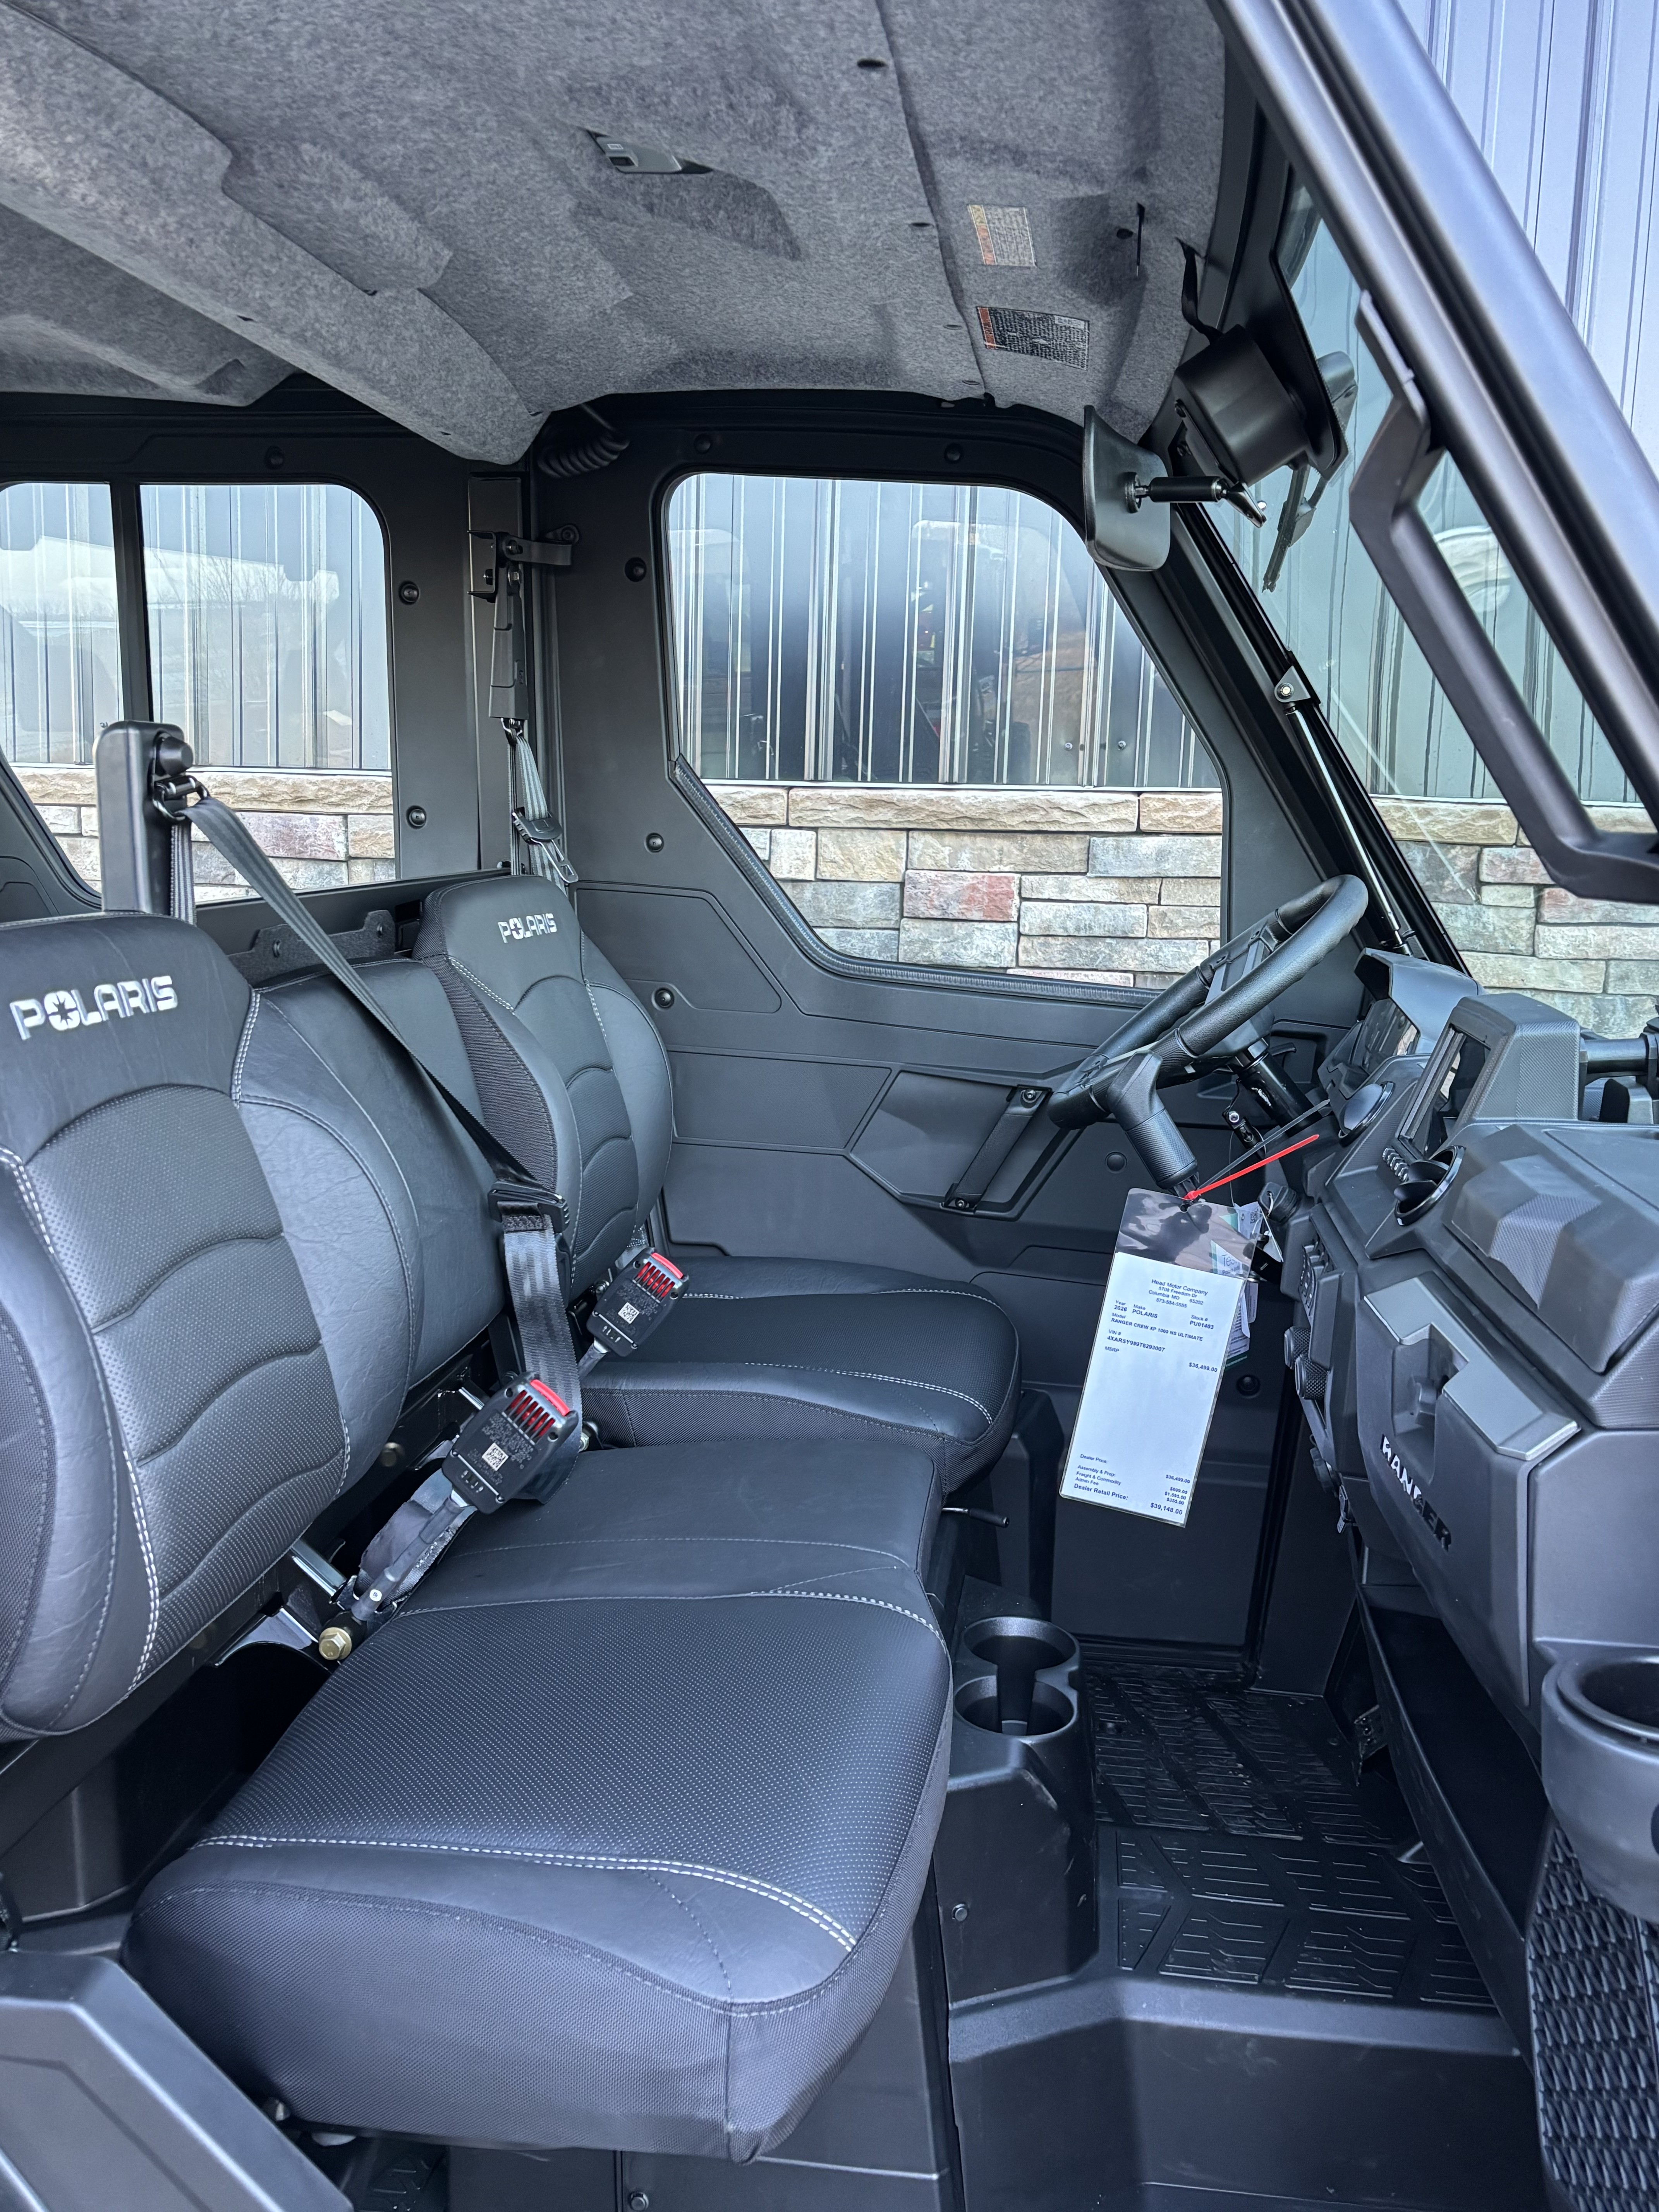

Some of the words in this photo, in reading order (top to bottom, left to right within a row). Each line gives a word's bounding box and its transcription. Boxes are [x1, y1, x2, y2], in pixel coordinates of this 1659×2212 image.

[498, 913, 557, 943] POLARIS
[9, 975, 178, 1041] POLARIS
[1183, 1286, 1208, 1296] Company
[1132, 1309, 1158, 1318] POLARIS
[1111, 1318, 1132, 1326] RANGER
[1178, 1333, 1203, 1341] ULTIMATE
[1190, 1321, 1214, 1329] PU01403
[1188, 1362, 1218, 1372] $36,499.00
[1077, 1465, 1099, 1474] Assembly
[1076, 1471, 1092, 1479] Freight
[1097, 1476, 1121, 1486] Commodity
[1074, 1484, 1092, 1492] Dealer
[1094, 1488, 1110, 1496] Retail
[1111, 1492, 1128, 1500] Price:
[1380, 1434, 1451, 1553] RANGER
[1151, 1503, 1183, 1515] $39,148.00
